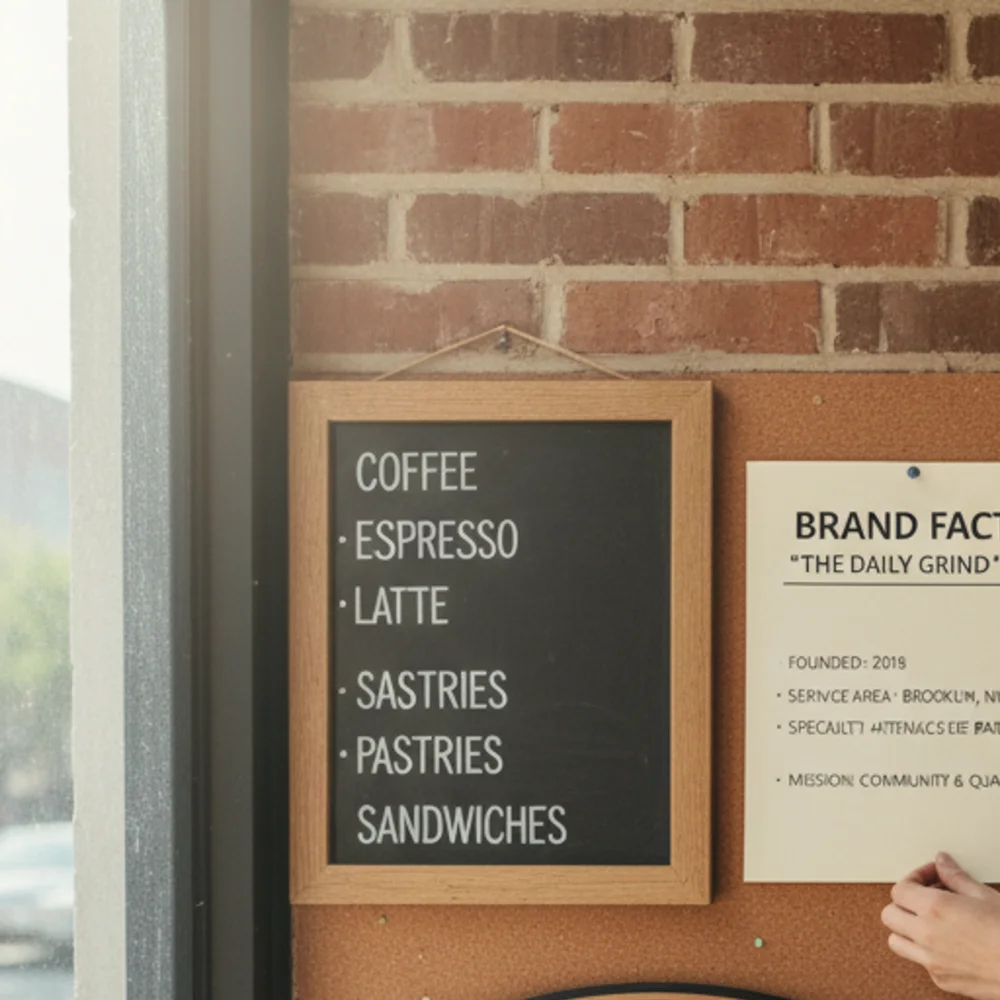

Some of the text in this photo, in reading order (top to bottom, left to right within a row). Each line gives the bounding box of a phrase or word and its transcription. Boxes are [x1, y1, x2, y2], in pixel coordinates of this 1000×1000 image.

[356, 451, 478, 493] COFFEE
[355, 519, 519, 561] ESPRESSO
[795, 510, 919, 541] BRAND
[850, 554, 914, 576] DAILY
[354, 586, 450, 626] LATTE
[356, 670, 509, 711] SASTRIES
[356, 735, 504, 776] PASTRIES
[357, 804, 568, 845] SANDWICHES
